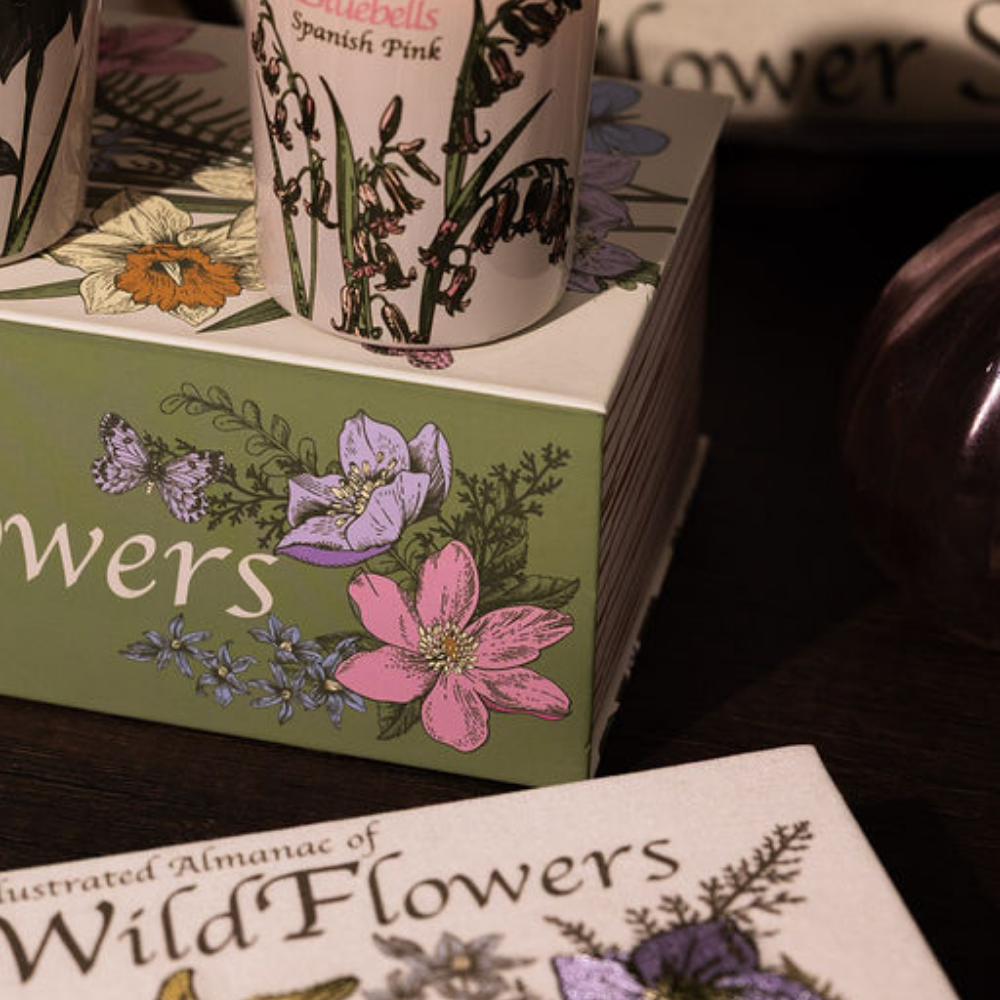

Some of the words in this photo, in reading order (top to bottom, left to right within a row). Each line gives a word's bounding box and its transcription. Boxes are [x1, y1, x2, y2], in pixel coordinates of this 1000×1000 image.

[291, 10, 375, 54] Spanish
[382, 34, 443, 61] Pink
[595, 0, 928, 104] lower
[167, 837, 333, 879] Almanac
[346, 820, 380, 858] of
